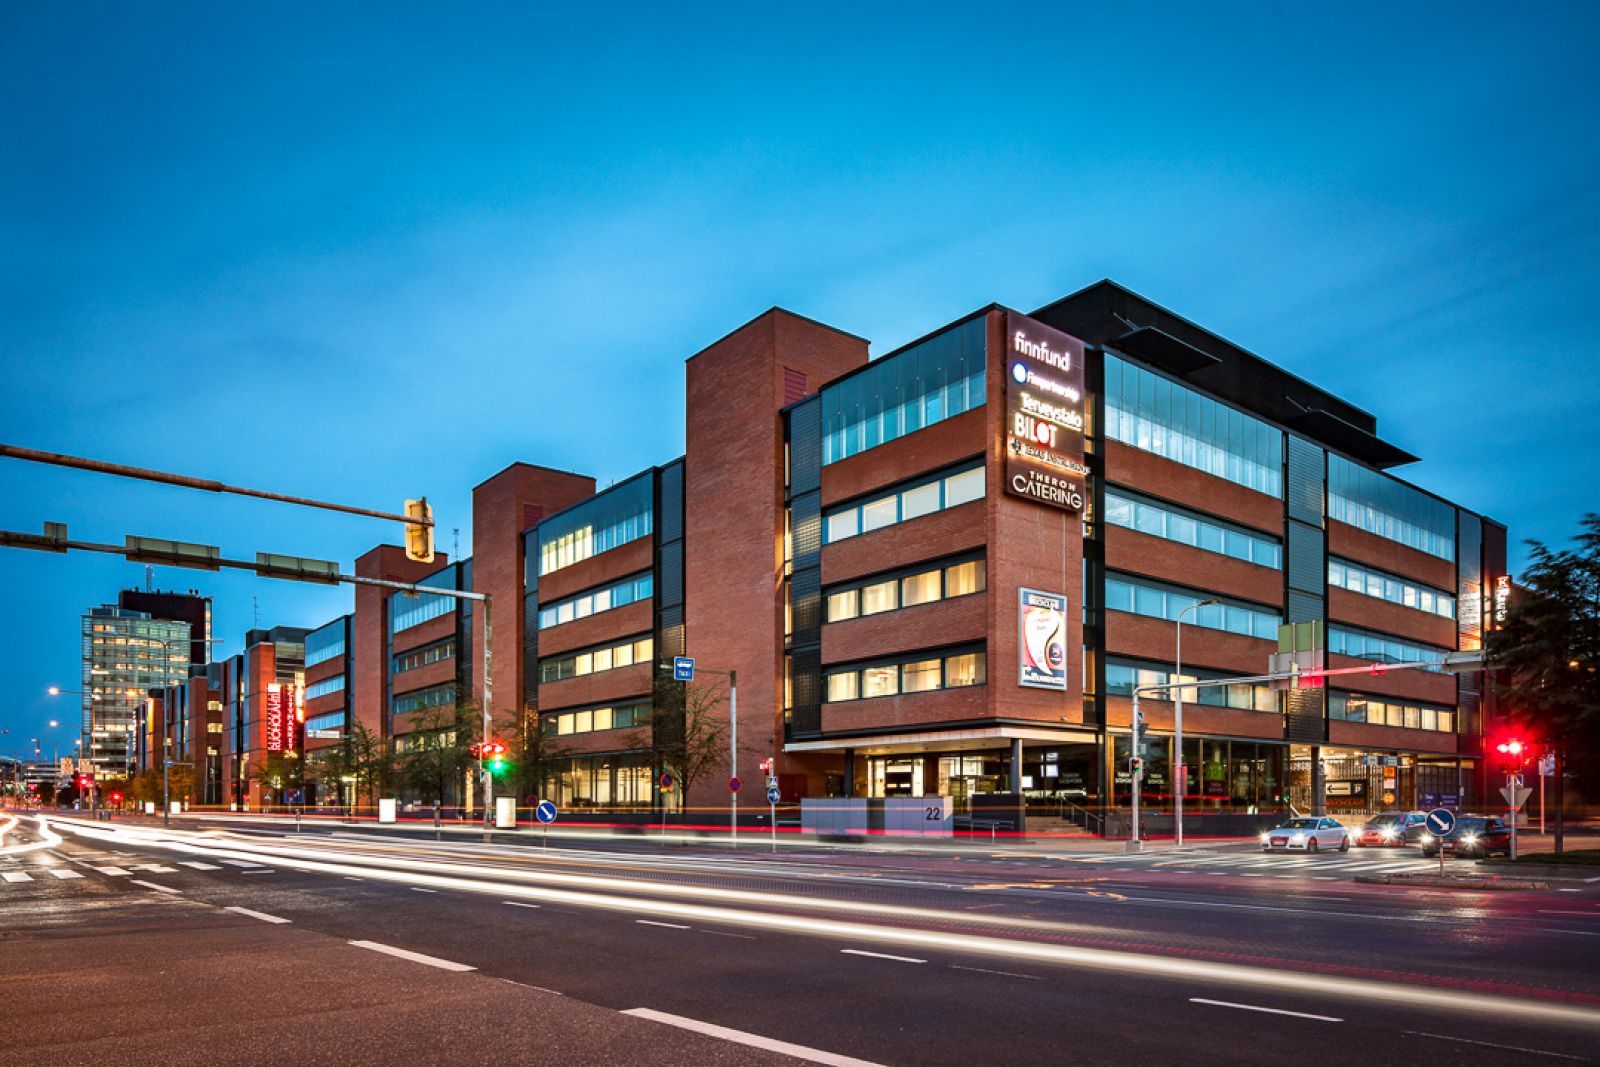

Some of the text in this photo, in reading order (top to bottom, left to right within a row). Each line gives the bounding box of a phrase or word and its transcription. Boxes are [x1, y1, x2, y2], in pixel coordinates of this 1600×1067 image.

[1014, 331, 1070, 372] finnfund
[1020, 391, 1083, 429] Terveystalo
[1014, 411, 1058, 448] BILOT
[1012, 474, 1083, 509] CATERING
[1029, 470, 1077, 492] THERON
[926, 807, 940, 820] 22
